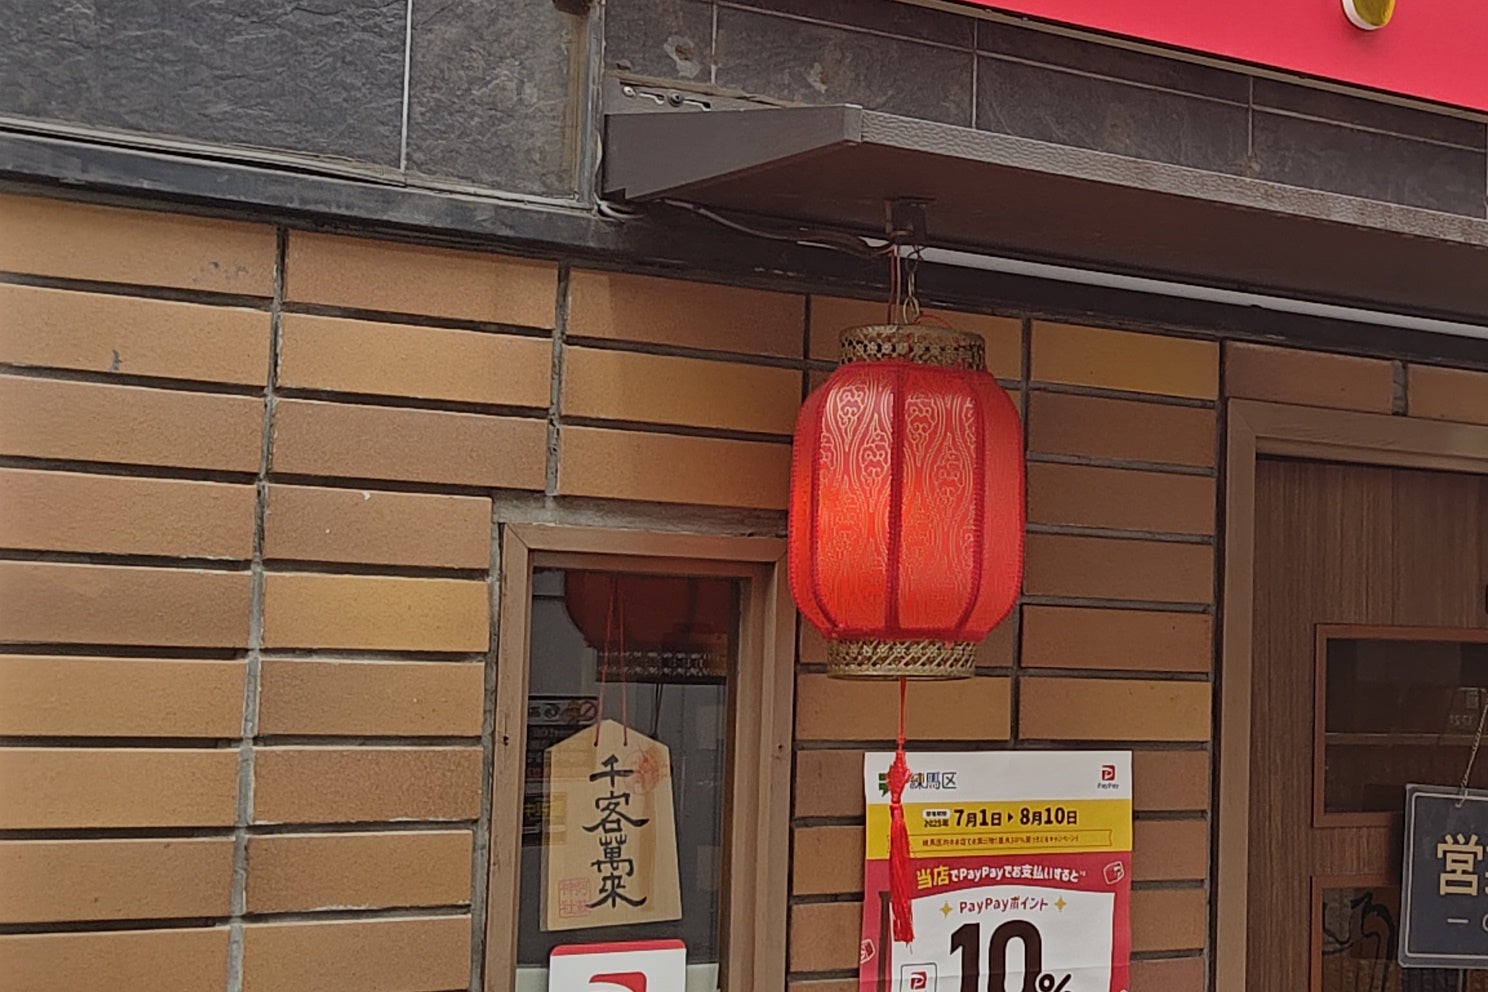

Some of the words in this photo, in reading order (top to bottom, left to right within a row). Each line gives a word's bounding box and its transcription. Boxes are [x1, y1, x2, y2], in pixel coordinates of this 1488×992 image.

[954, 808, 1002, 828] 7月1日
[1019, 806, 1078, 827] 8月10日
[959, 895, 1049, 914] PayPayポイント
